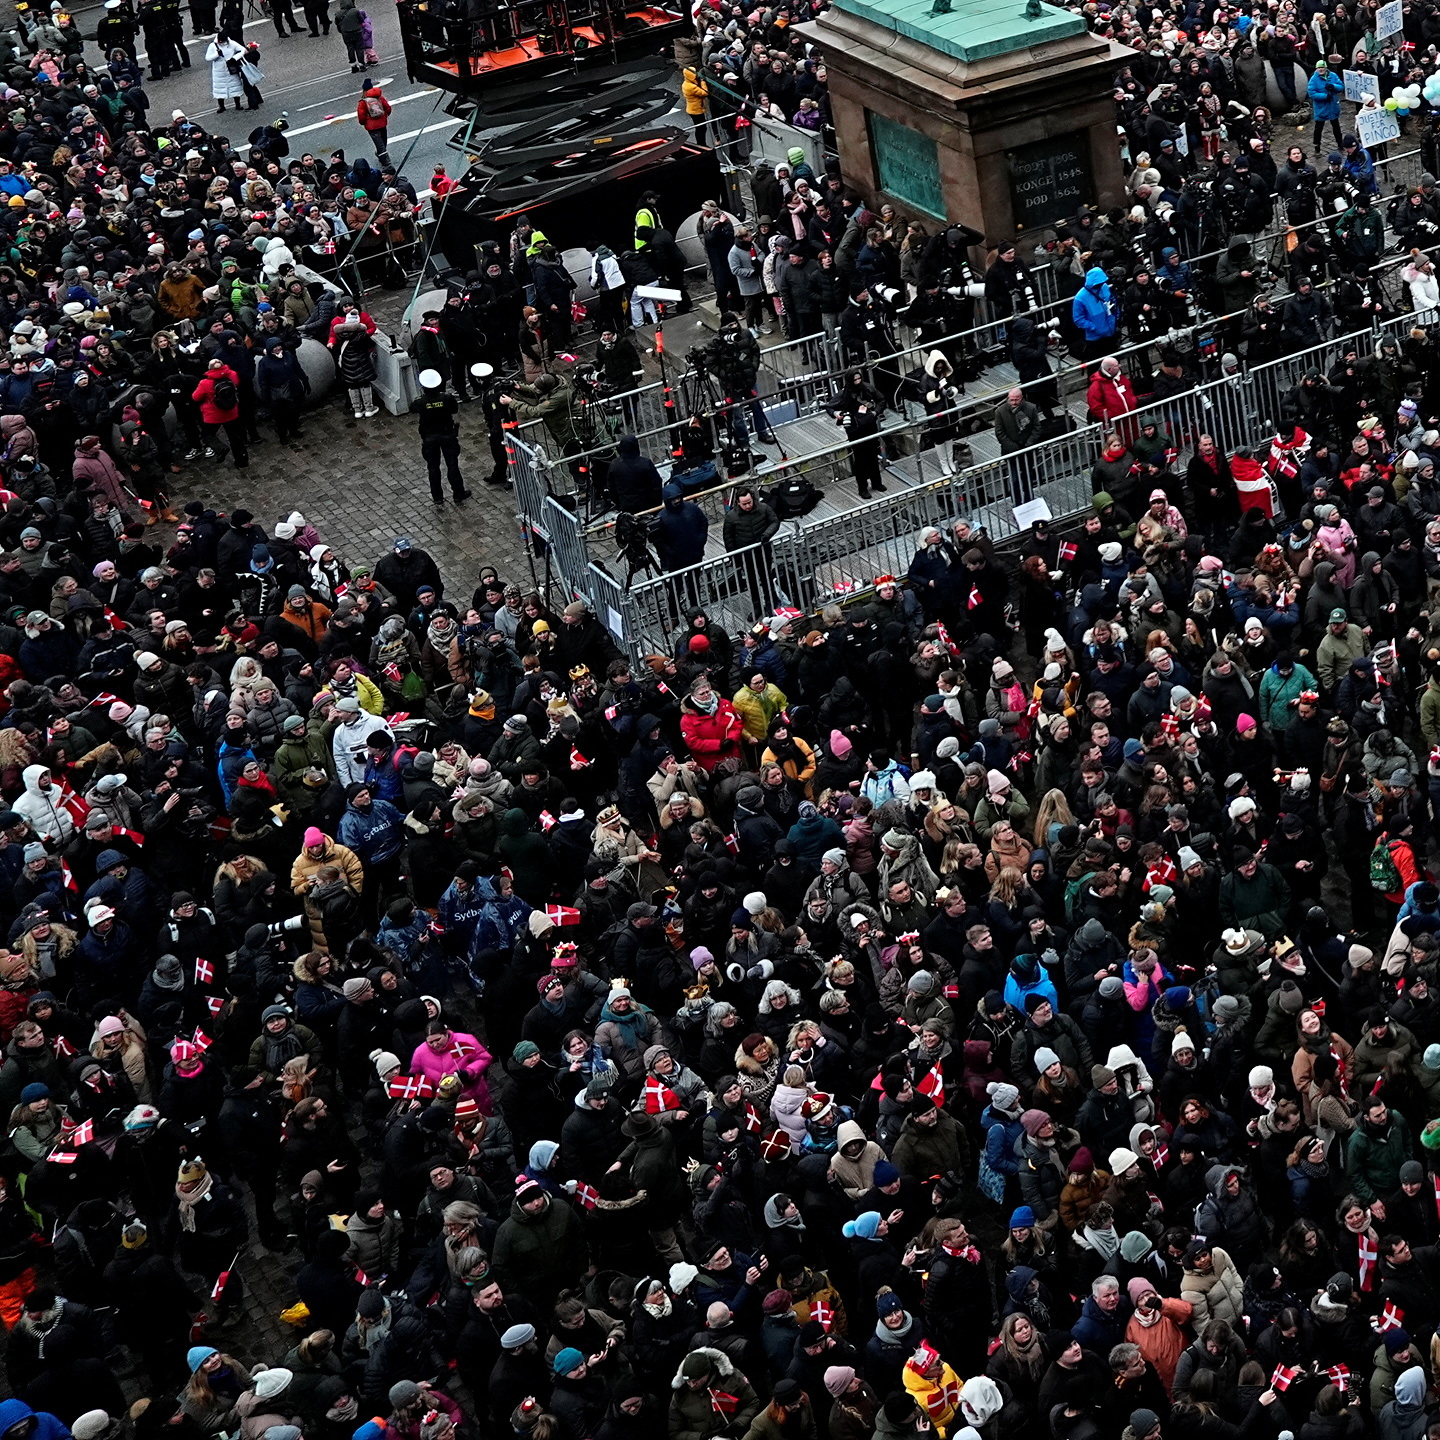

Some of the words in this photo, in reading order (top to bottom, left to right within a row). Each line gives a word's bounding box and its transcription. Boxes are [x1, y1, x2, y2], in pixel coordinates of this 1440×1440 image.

[1378, 2, 1399, 20] JUSTICE
[1384, 13, 1395, 24] FOR
[1379, 19, 1401, 37] PINGO
[1345, 72, 1375, 86] JUSTICE
[1355, 83, 1368, 91] FOR
[1346, 89, 1377, 100] PINO
[1359, 110, 1391, 126] JUSTICE
[1371, 119, 1385, 130] FOR
[1364, 124, 1398, 144] PINGO
[1016, 175, 1054, 193] KONGE
[1025, 194, 1048, 208] DØD
[454, 908, 482, 923] Sydba
